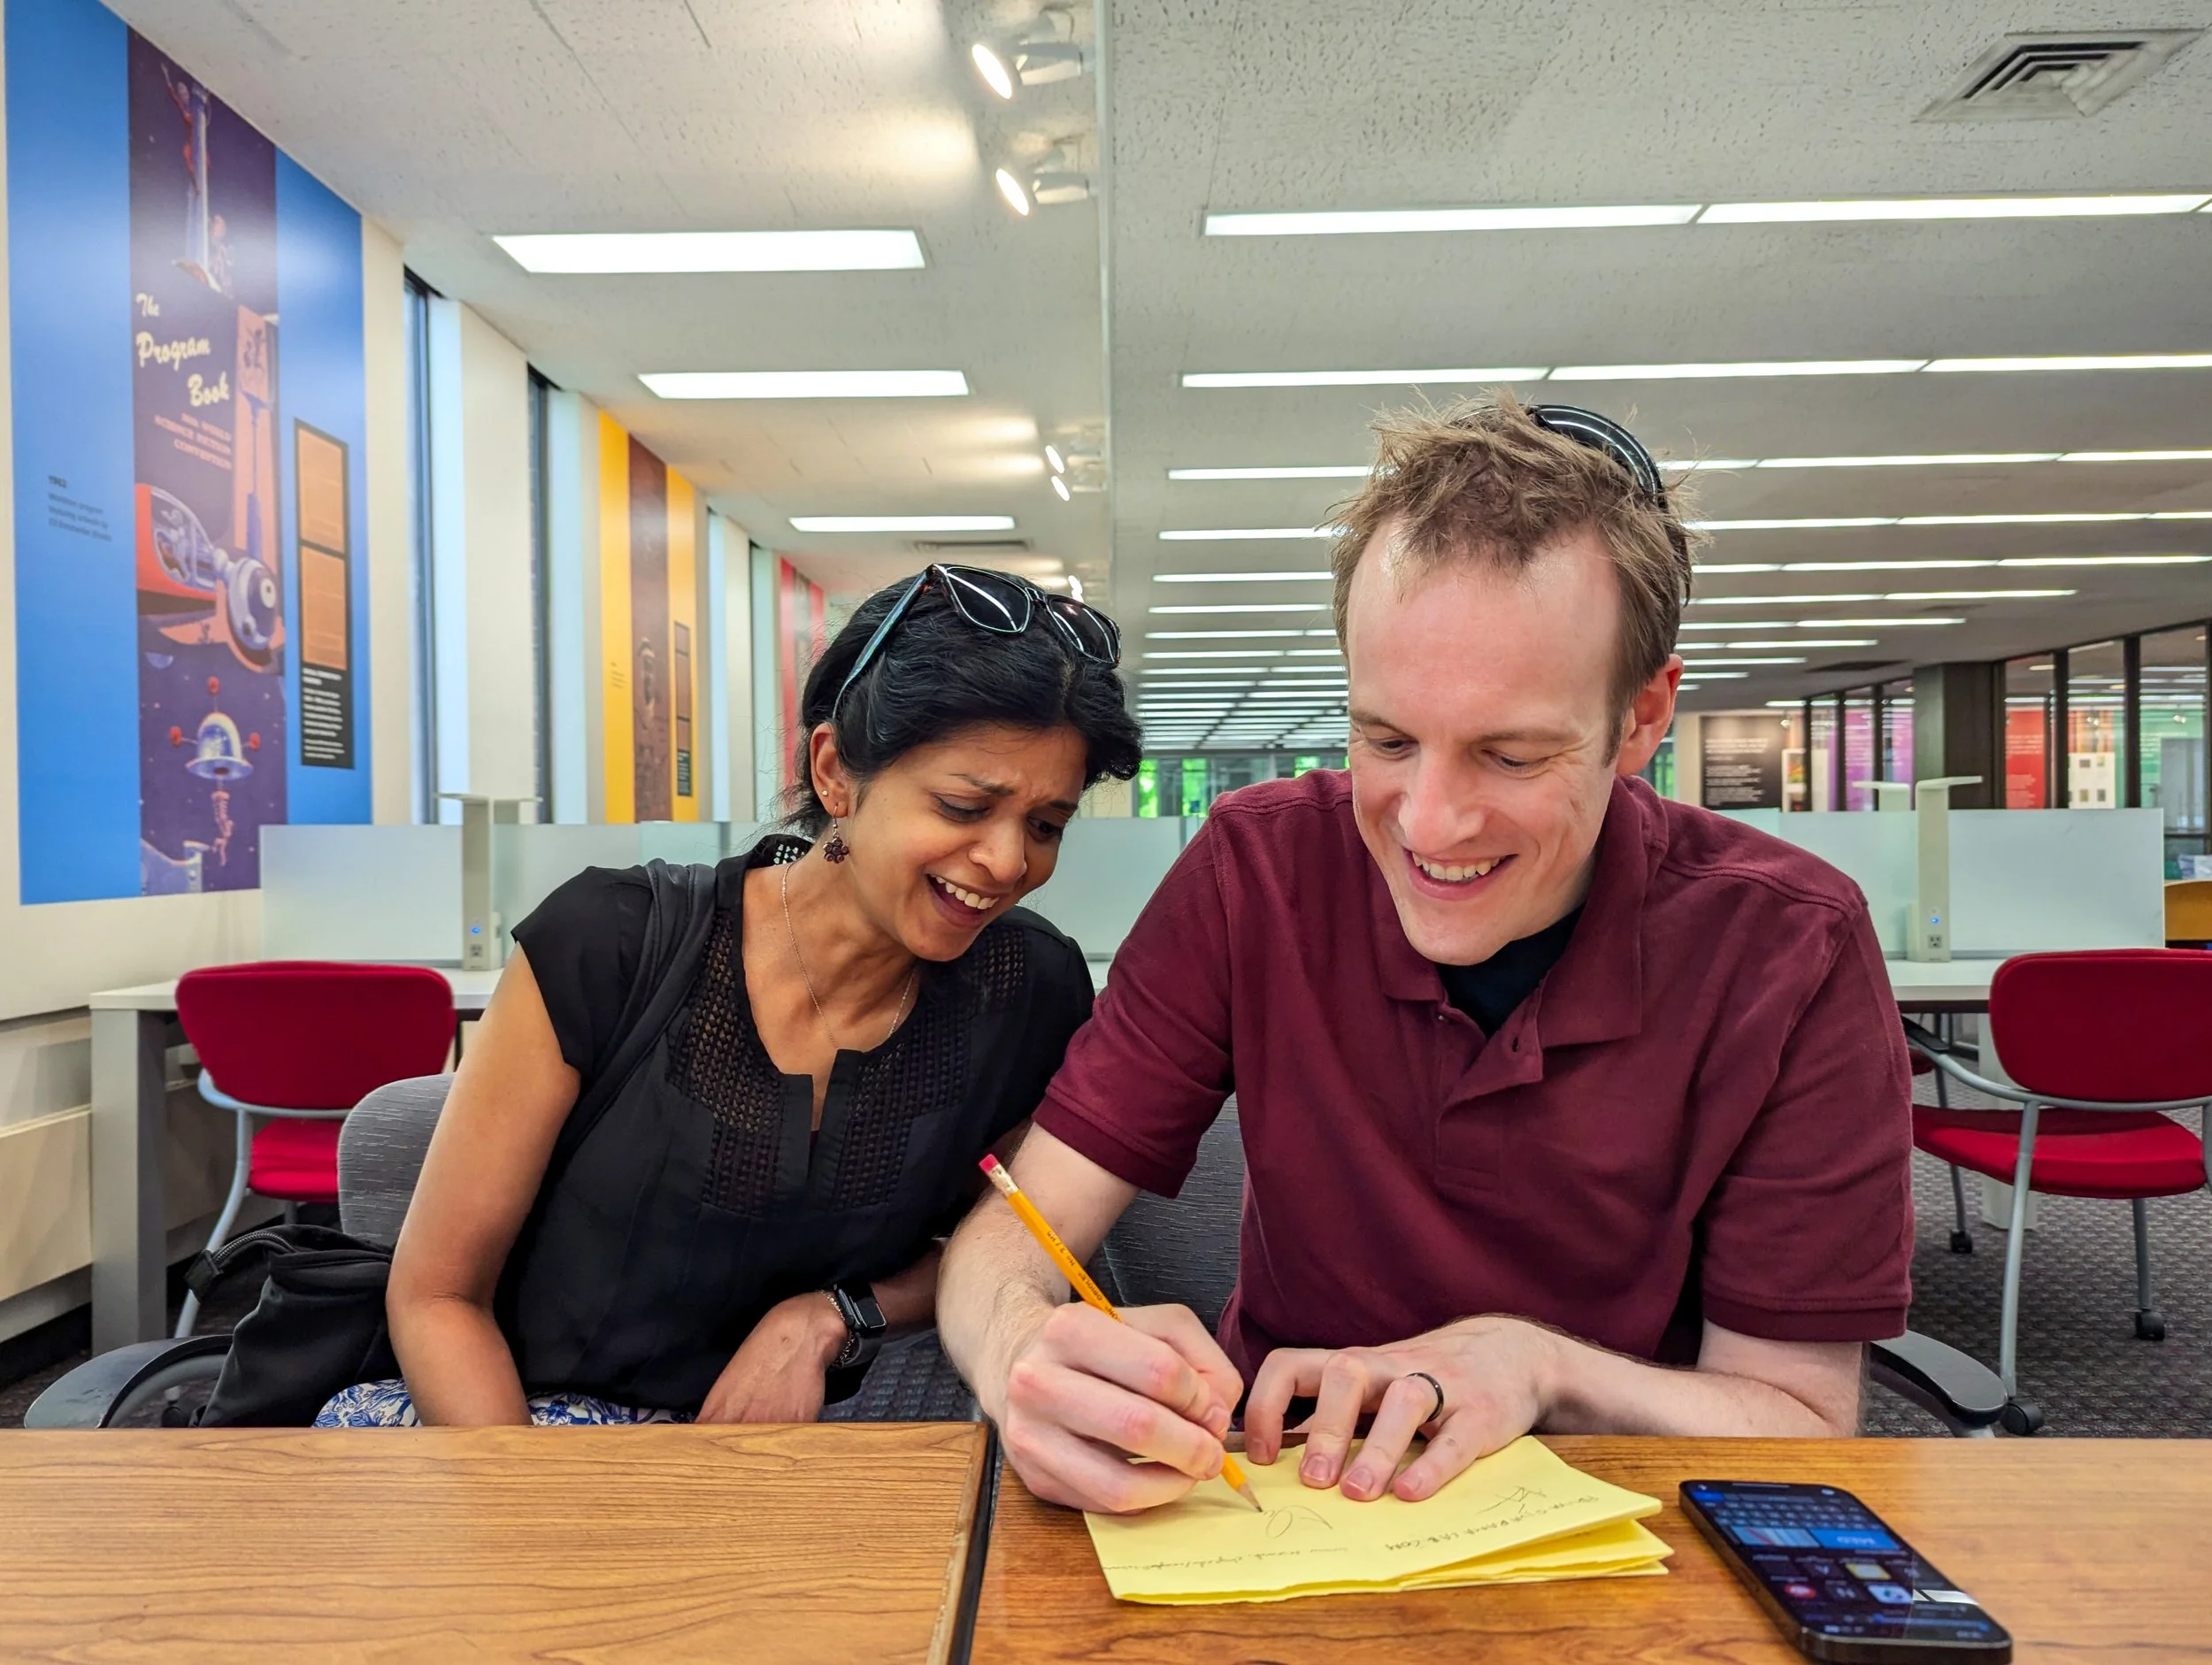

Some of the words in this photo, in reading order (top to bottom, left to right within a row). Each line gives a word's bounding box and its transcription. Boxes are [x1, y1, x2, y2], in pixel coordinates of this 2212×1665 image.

[135, 292, 159, 317] The
[135, 331, 211, 372] Program
[187, 371, 229, 407] Book
